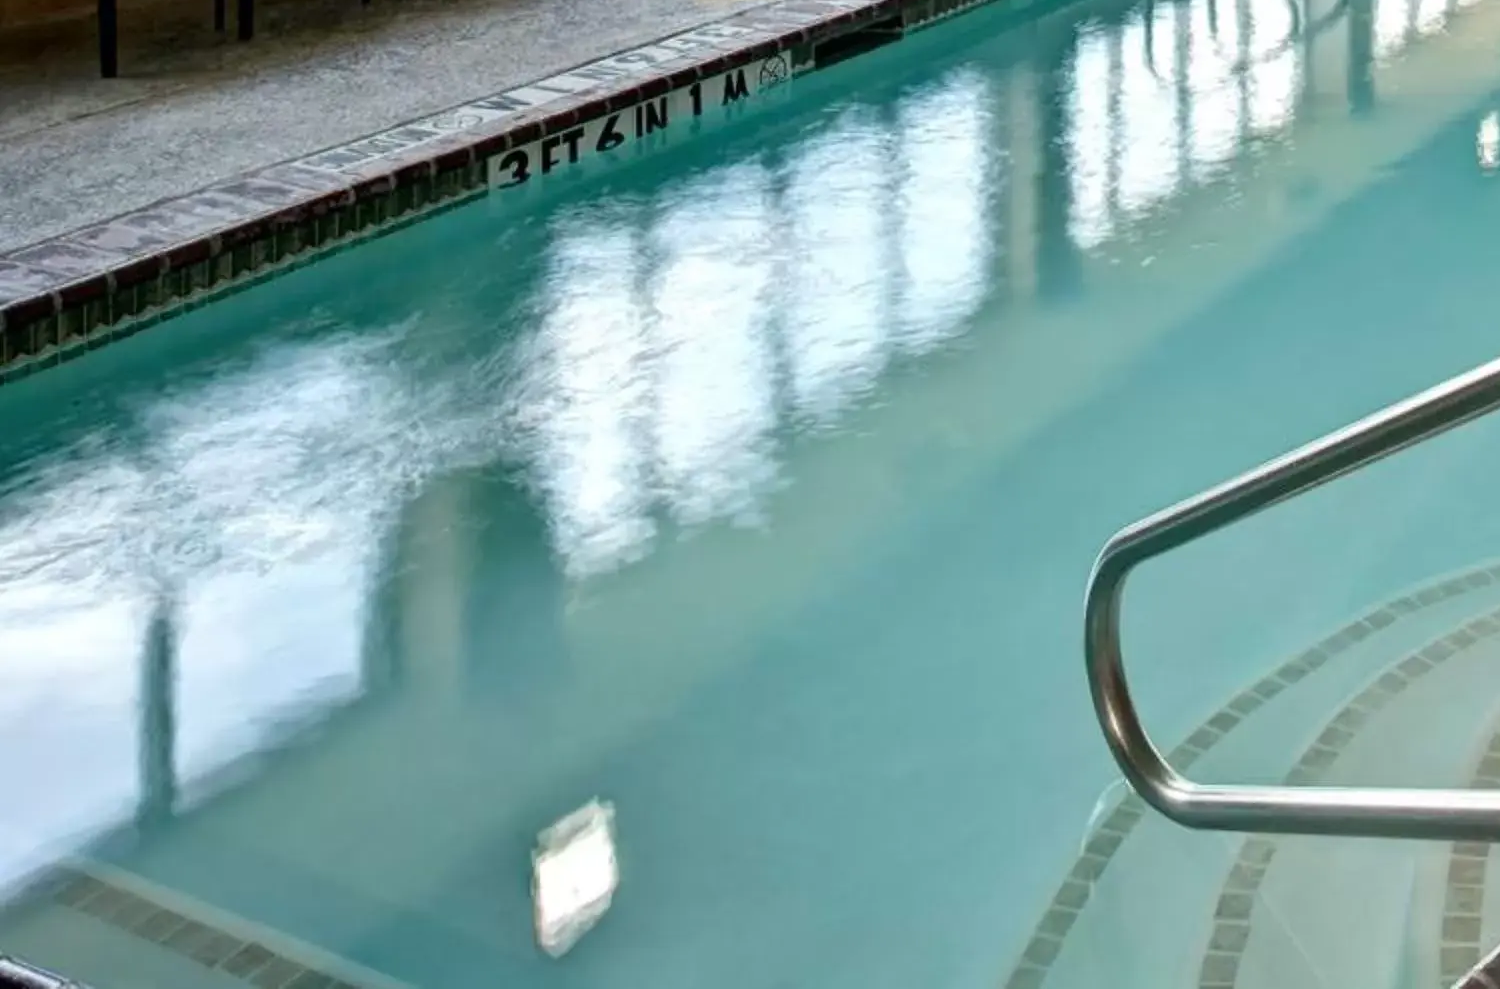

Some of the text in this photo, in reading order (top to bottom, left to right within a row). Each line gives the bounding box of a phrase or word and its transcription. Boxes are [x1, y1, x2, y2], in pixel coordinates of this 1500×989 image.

[498, 69, 750, 189] 3 FT 6 IN 1 M
